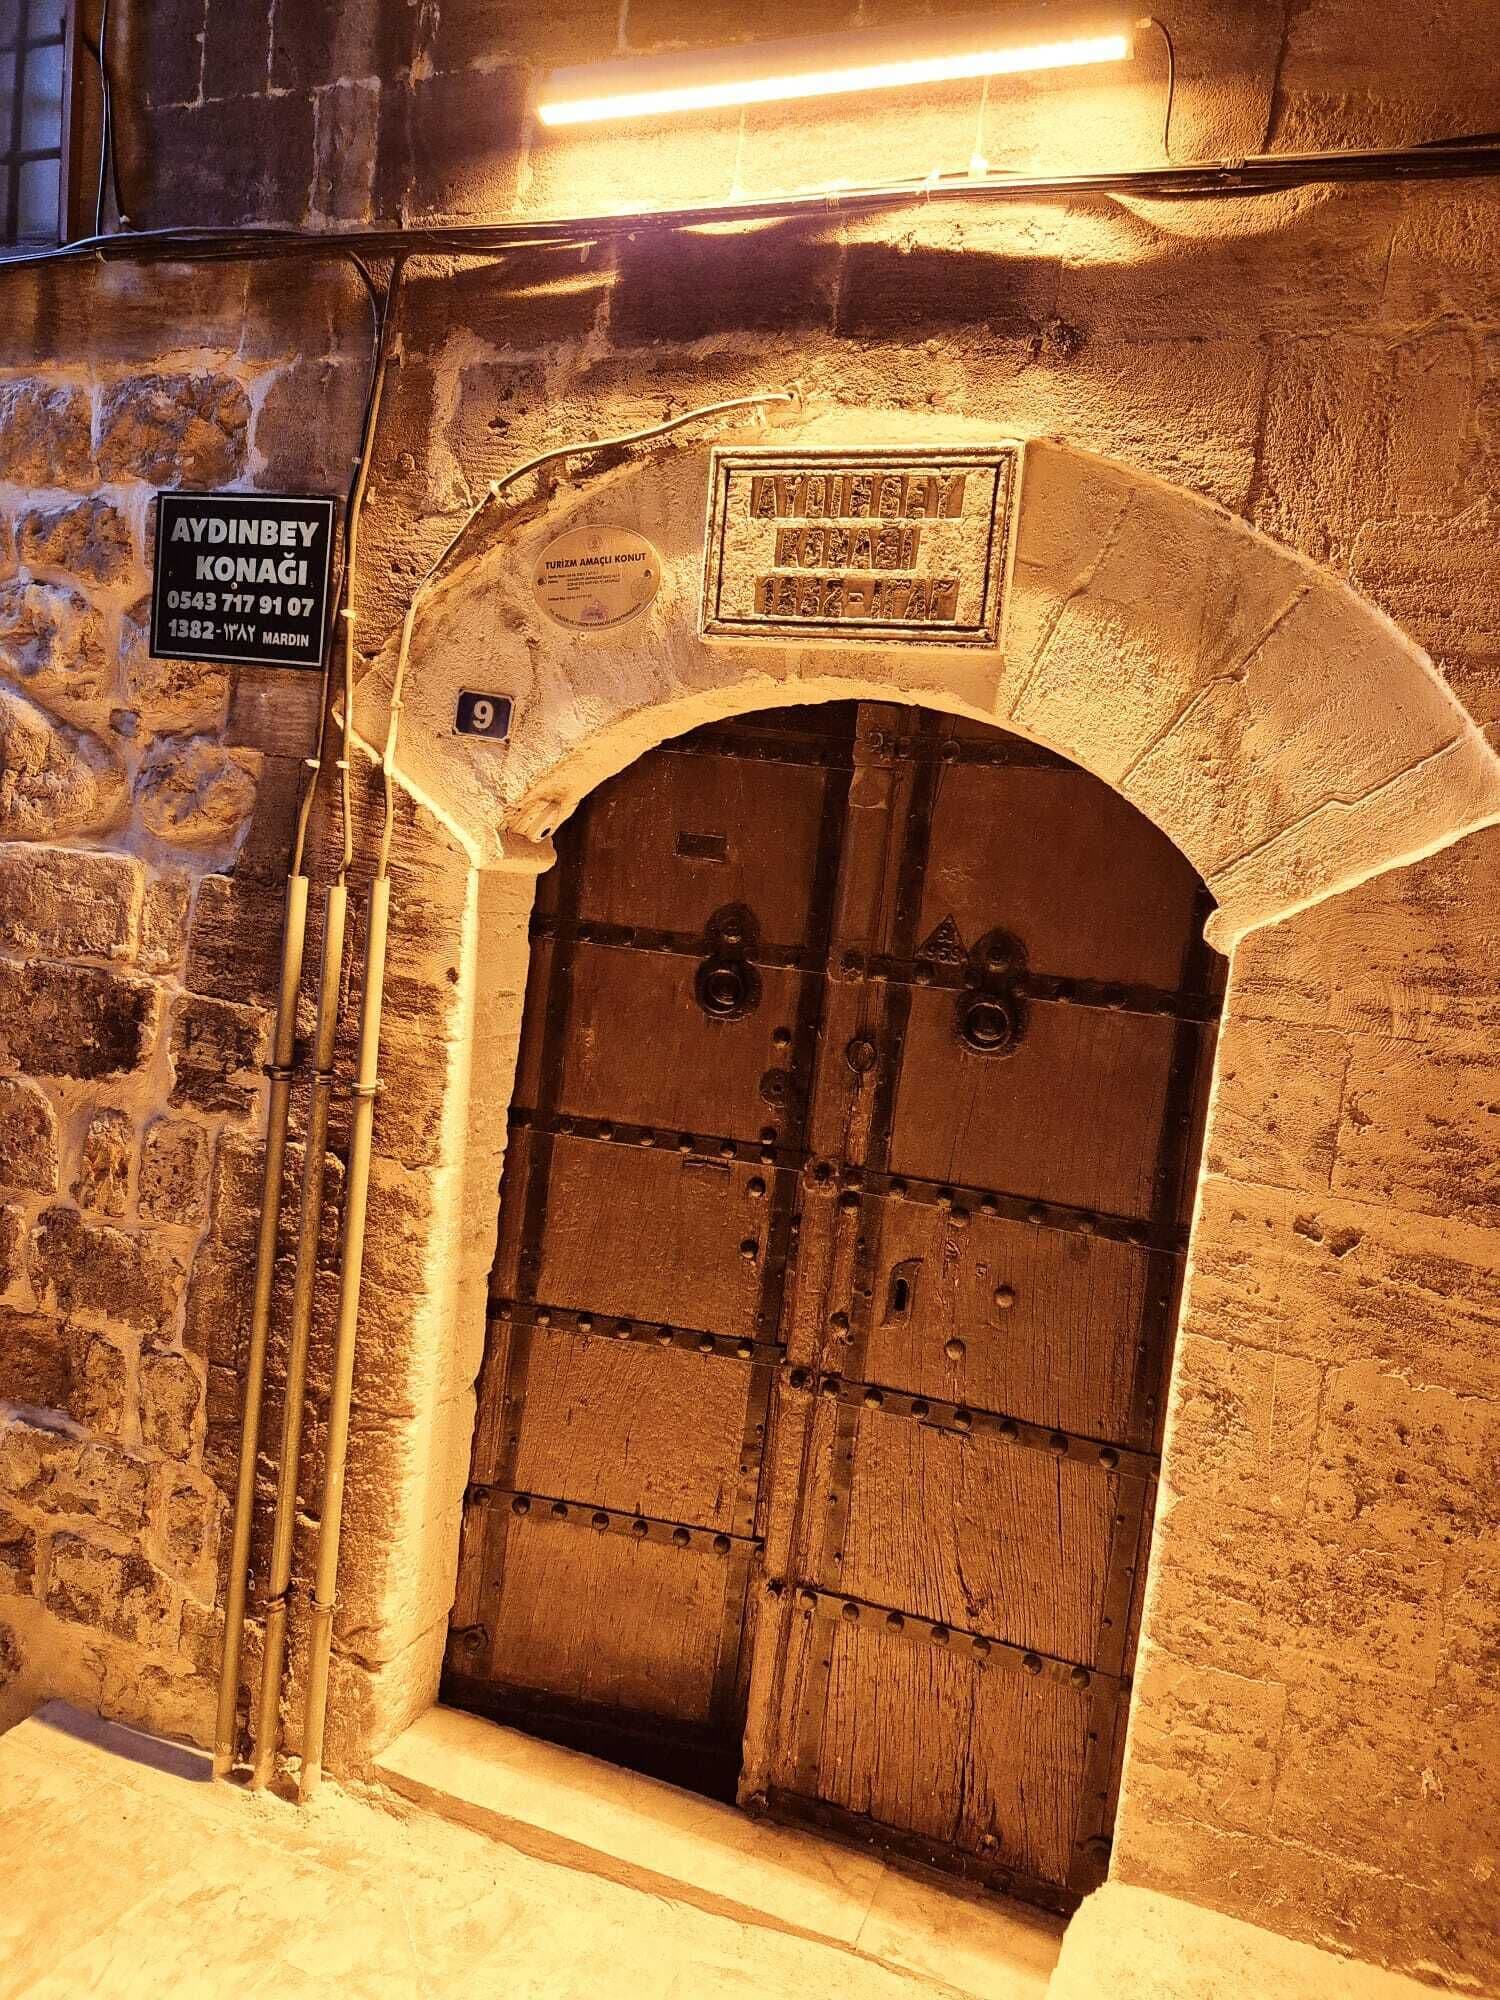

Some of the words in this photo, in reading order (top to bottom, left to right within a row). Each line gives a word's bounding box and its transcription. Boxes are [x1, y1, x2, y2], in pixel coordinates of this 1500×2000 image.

[170, 517, 319, 548] AYDINBEY
[195, 552, 308, 586] KONAĞI
[545, 558, 577, 569] TURİZM
[580, 555, 612, 567] AMAÇLI
[614, 552, 646, 563] KONUT
[167, 590, 217, 611] 0543
[221, 593, 255, 613] 717
[259, 595, 282, 615] 91
[287, 597, 315, 617] 07
[262, 631, 309, 647] MARDIN
[472, 700, 494, 729] 9
